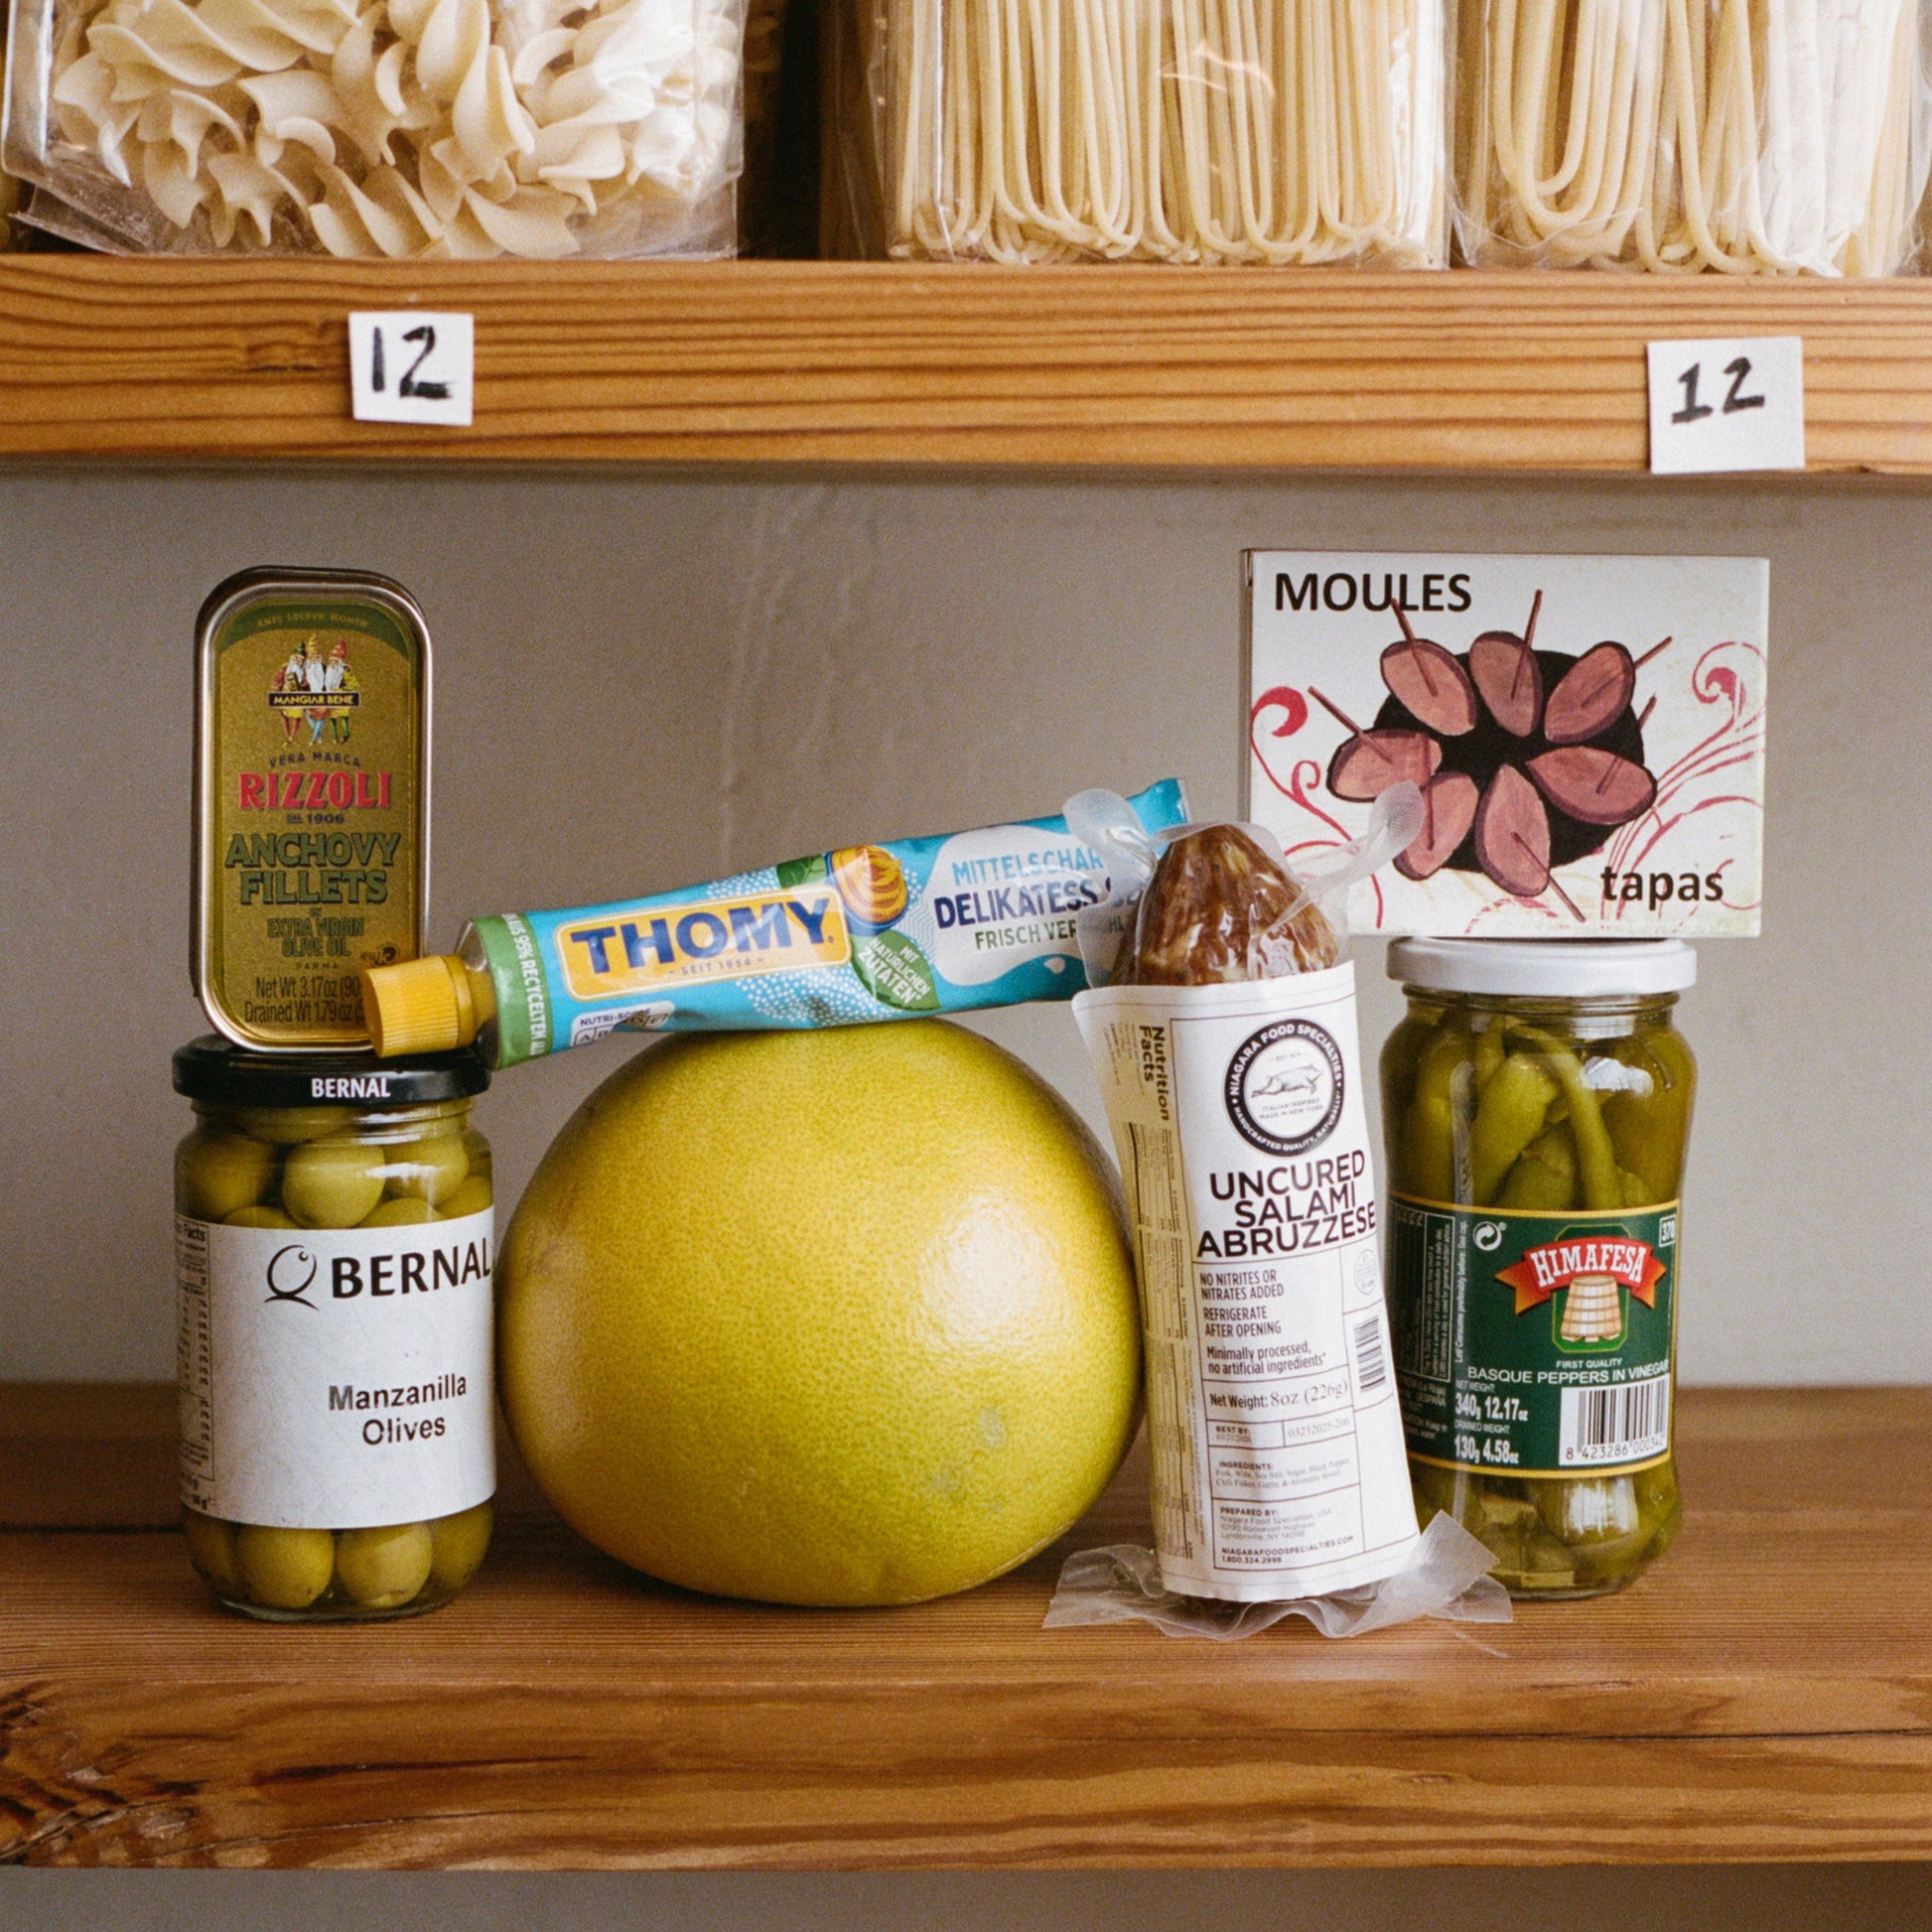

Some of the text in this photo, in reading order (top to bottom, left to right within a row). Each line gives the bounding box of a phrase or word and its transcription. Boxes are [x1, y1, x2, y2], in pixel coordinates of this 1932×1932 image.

[371, 325, 453, 399] 12
[1672, 356, 1765, 424] 12
[1275, 573, 1471, 612] MOULES
[273, 694, 354, 706] MANGIAR BENE
[269, 752, 361, 768] VERA MARCA
[237, 770, 392, 810] RIZZOLI
[307, 813, 345, 824] 1906
[224, 832, 402, 869] ANCHOVY
[951, 846, 1105, 887] MITTELSCHAR
[240, 869, 388, 905] FILLETS
[1600, 867, 1724, 909] tapas
[267, 916, 365, 937] EXTRA VIRGIN
[569, 897, 831, 974] THOMY
[974, 921, 1041, 950] FRISCH
[282, 937, 325, 957] OLIVE
[326, 937, 351, 957] OIL
[513, 934, 534, 960] 95%
[899, 945, 920, 963] MIT
[681, 963, 713, 976] SEIT
[255, 977, 278, 998] Net
[279, 976, 297, 998] Wt
[244, 1000, 293, 1023] Drained
[295, 1001, 314, 1023] Wt
[1139, 1025, 1155, 1082] Facts
[1229, 1024, 1342, 1096] NIAGARA FOOD SPECIALTIES
[1152, 1026, 1171, 1122] Nutrition
[311, 1077, 391, 1098] BERNAL
[1233, 1106, 1282, 1151] HANDCRAFTED
[1209, 1149, 1366, 1200] UNCURED
[1233, 1180, 1356, 1229] SALAMI
[1195, 1201, 1377, 1259] ABRUZZESE
[331, 1237, 491, 1299] BERNAL
[1199, 1269, 1277, 1287] NO NITRITES OR
[1530, 1243, 1644, 1287] HIMAFESA
[1201, 1284, 1285, 1302] NITRATES ADDED
[1203, 1306, 1268, 1321] REFRIGERATE
[1204, 1320, 1282, 1338] AFTER OPENING
[1206, 1340, 1311, 1362] Minimally processed,
[1556, 1357, 1622, 1369] FIRST QUALITY
[1208, 1363, 1221, 1374] no
[1222, 1360, 1265, 1375] artificial
[1468, 1358, 1670, 1385] BASQUE PEPPERS IN VINEGAR
[328, 1373, 468, 1411] Manzanilla
[1209, 1380, 1349, 1410] Net Weight: 8oz (226g)
[1454, 1380, 1469, 1390] NET
[1454, 1392, 1481, 1420] 340g
[361, 1417, 447, 1446] Olives
[1215, 1425, 1237, 1434] BEST
[1453, 1419, 1482, 1432] DRAINED
[1454, 1435, 1480, 1463] 130g
[1566, 1447, 1574, 1460] 8
[1220, 1507, 1263, 1516] PREPARED
[1220, 1515, 1249, 1525] Niagara
[1221, 1535, 1354, 1556] NIAGARAFOODSPECIALTIES.COM
